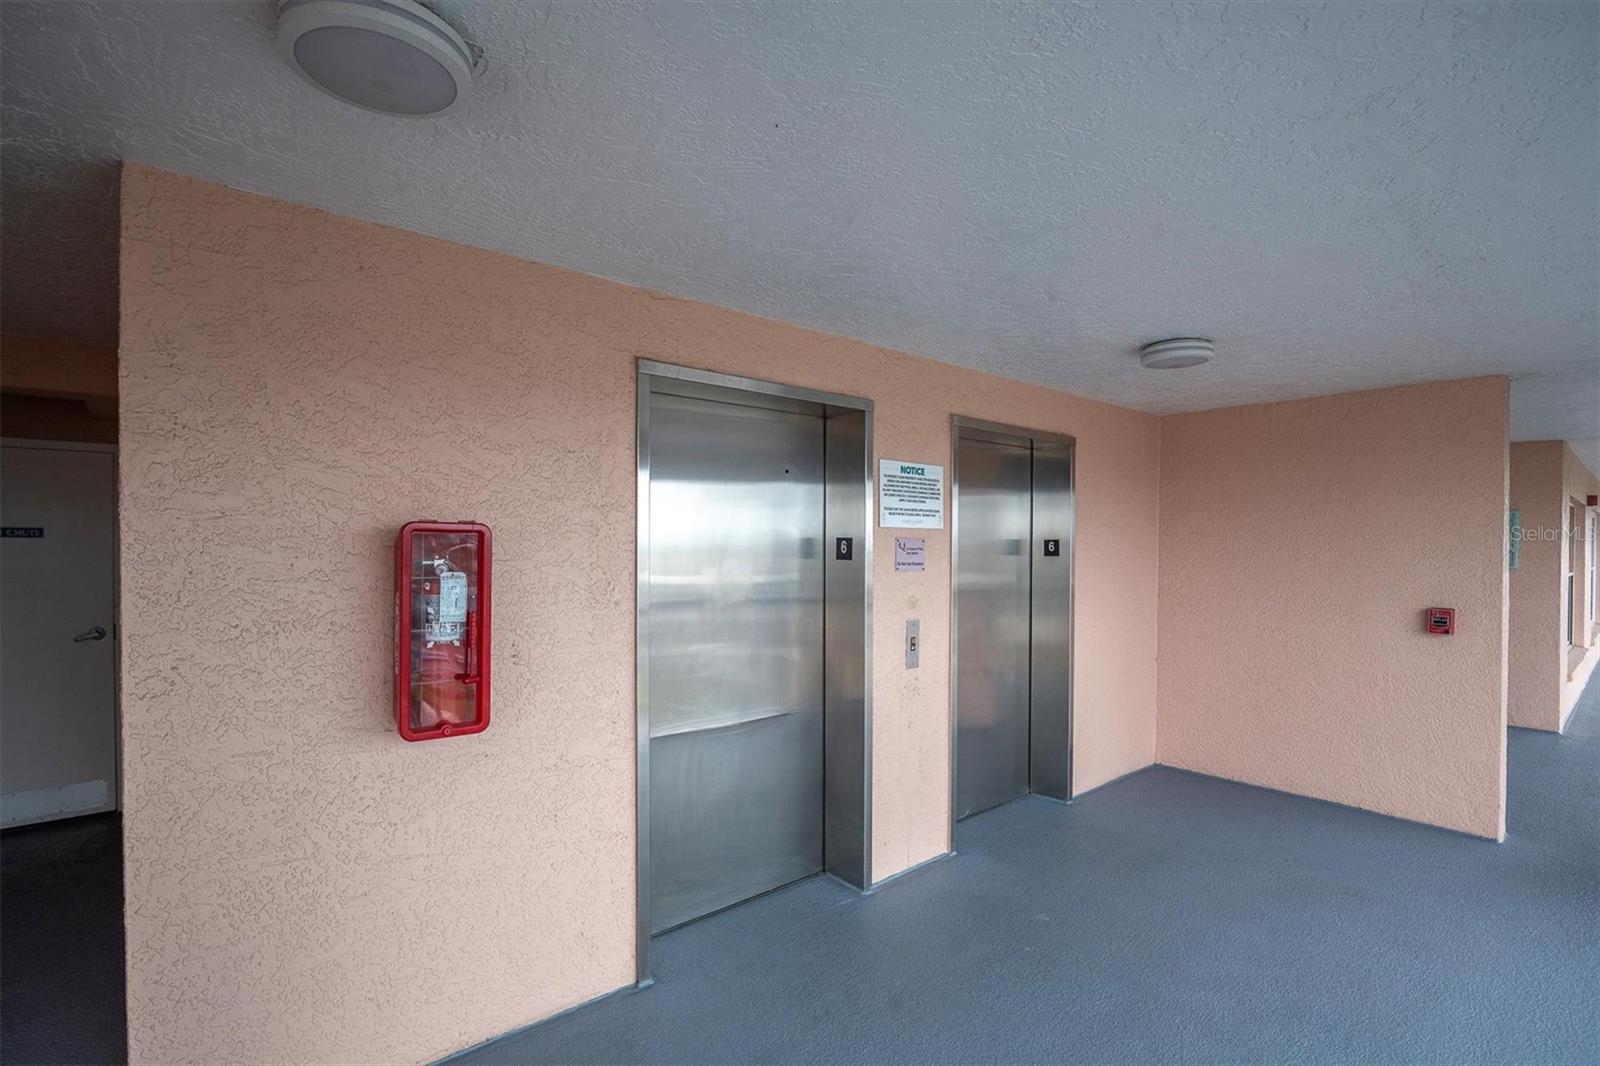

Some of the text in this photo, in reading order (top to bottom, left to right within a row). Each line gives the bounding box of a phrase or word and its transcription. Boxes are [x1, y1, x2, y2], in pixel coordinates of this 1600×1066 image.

[900, 465, 925, 476] NOTICE
[841, 540, 847, 554] 6
[1049, 541, 1055, 552] 6
